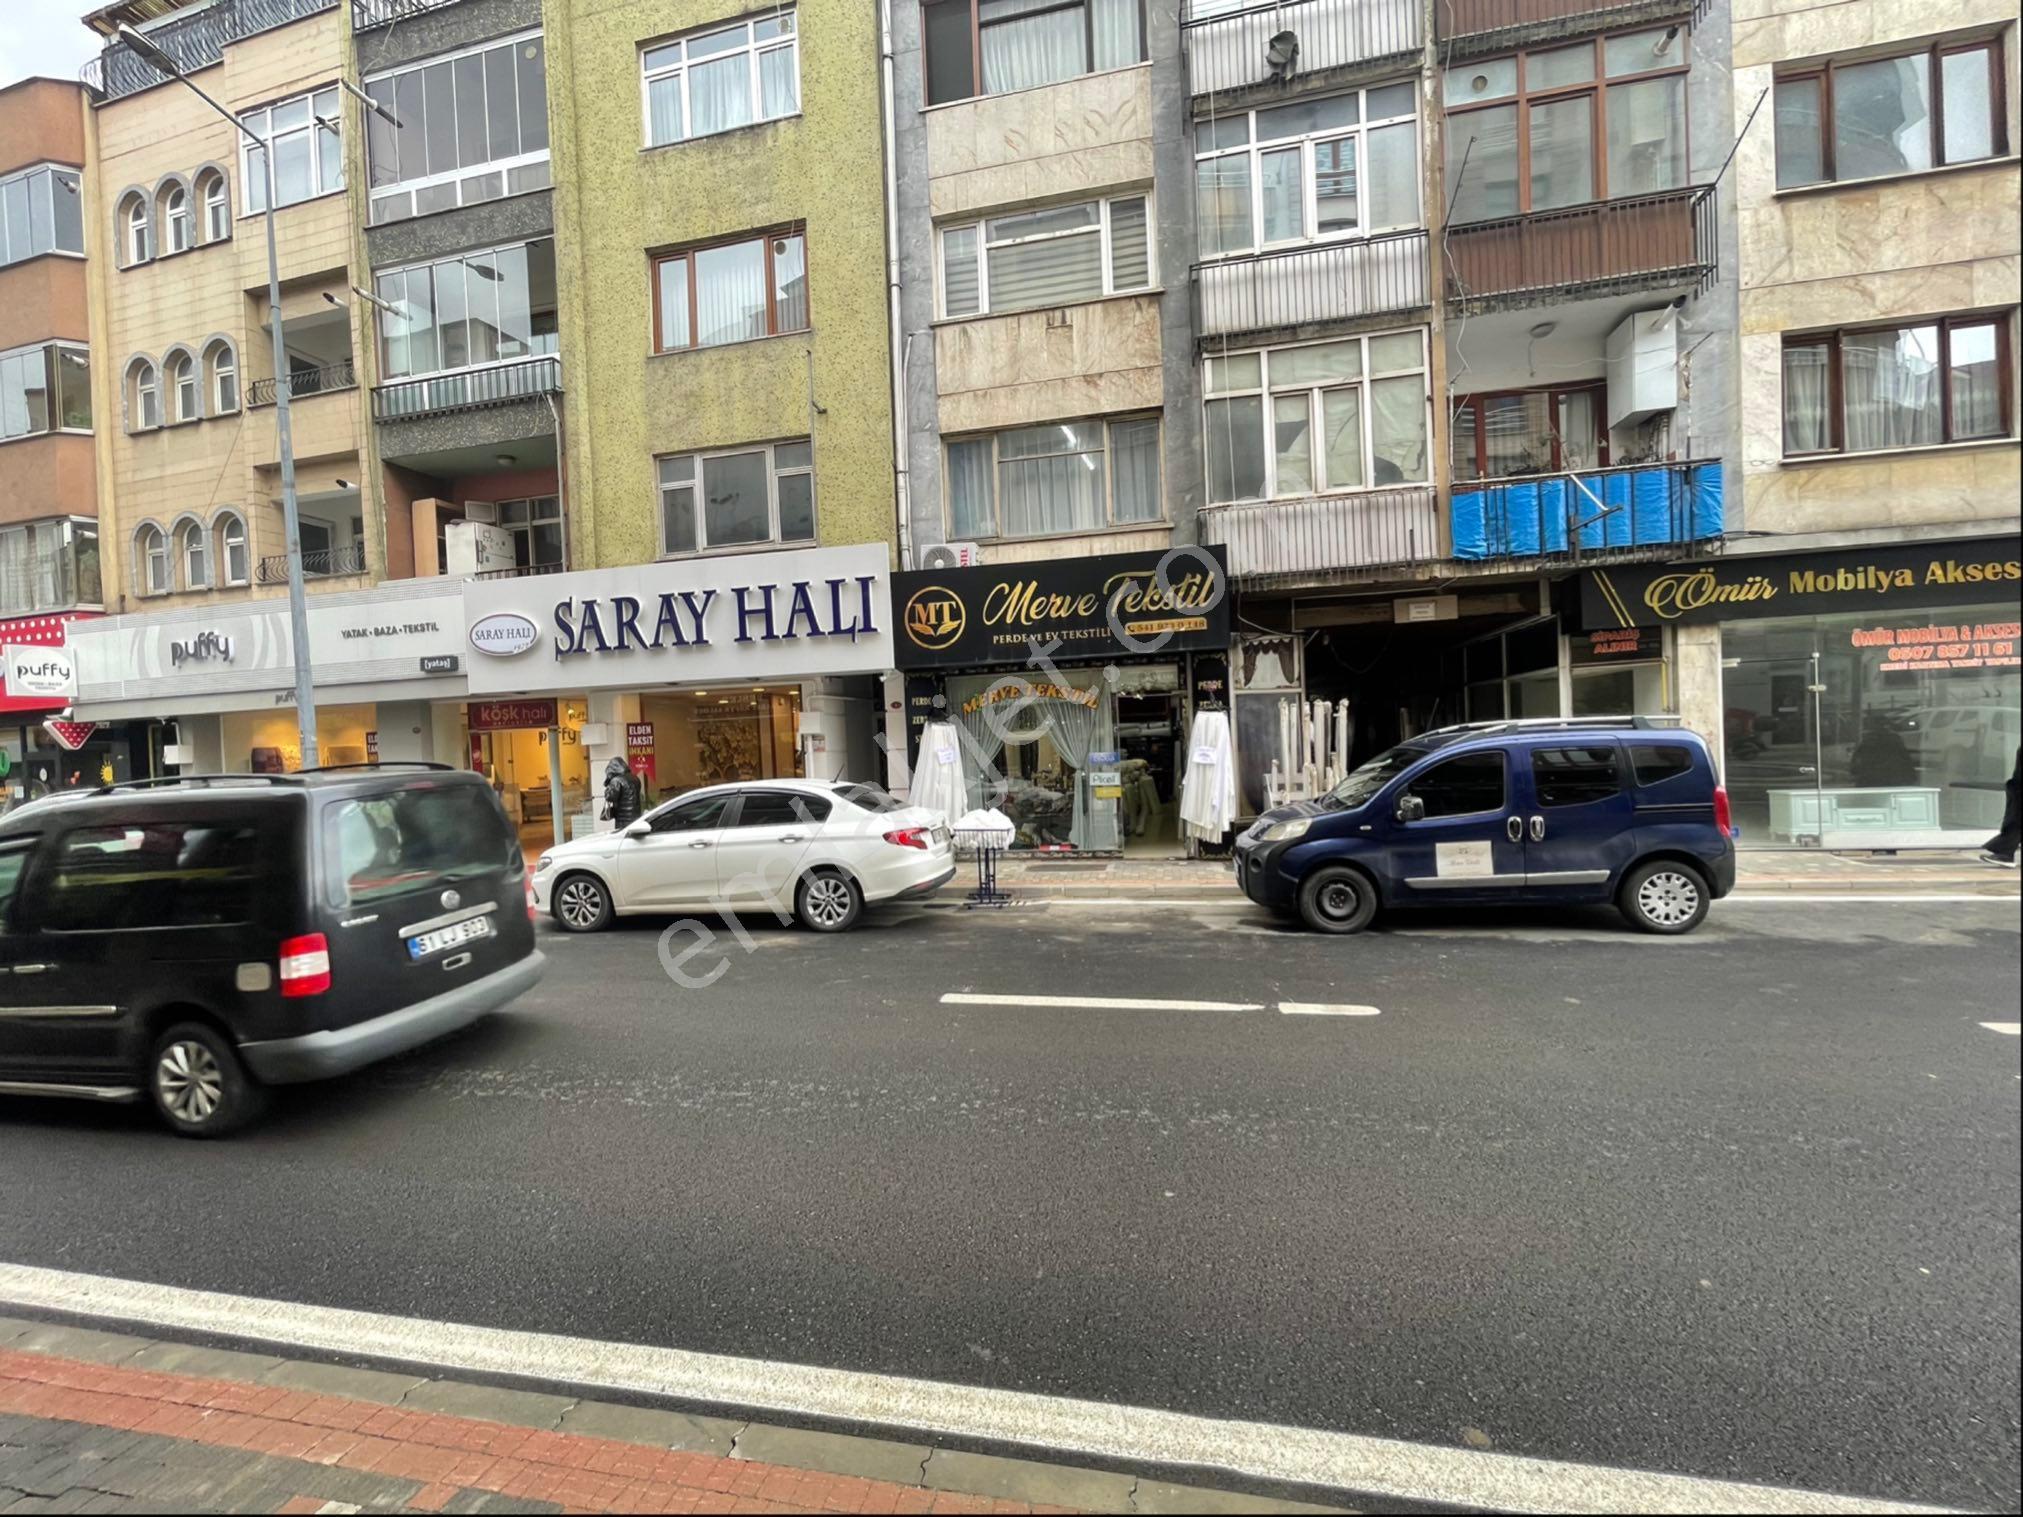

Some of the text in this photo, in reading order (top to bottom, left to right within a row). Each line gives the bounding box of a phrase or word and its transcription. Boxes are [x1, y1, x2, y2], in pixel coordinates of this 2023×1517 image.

[1643, 560, 2021, 618] Ömür Mobilya Akses
[983, 570, 1216, 626] Merve Tekstil
[553, 575, 880, 662] SARAY HALI
[913, 600, 957, 626] MT
[341, 628, 369, 639] YATAK
[374, 626, 399, 637] BAZA
[475, 627, 531, 641] SARAY HALI
[993, 633, 1028, 645] PERDE
[1029, 633, 1042, 642] VE
[1046, 631, 1059, 641] EV
[171, 631, 230, 667] puffy
[1888, 646, 1934, 661] 0507
[17, 663, 71, 680] puffy
[275, 690, 296, 704] puff
[962, 685, 1021, 714] MERVE
[629, 725, 652, 735] ELDEN
